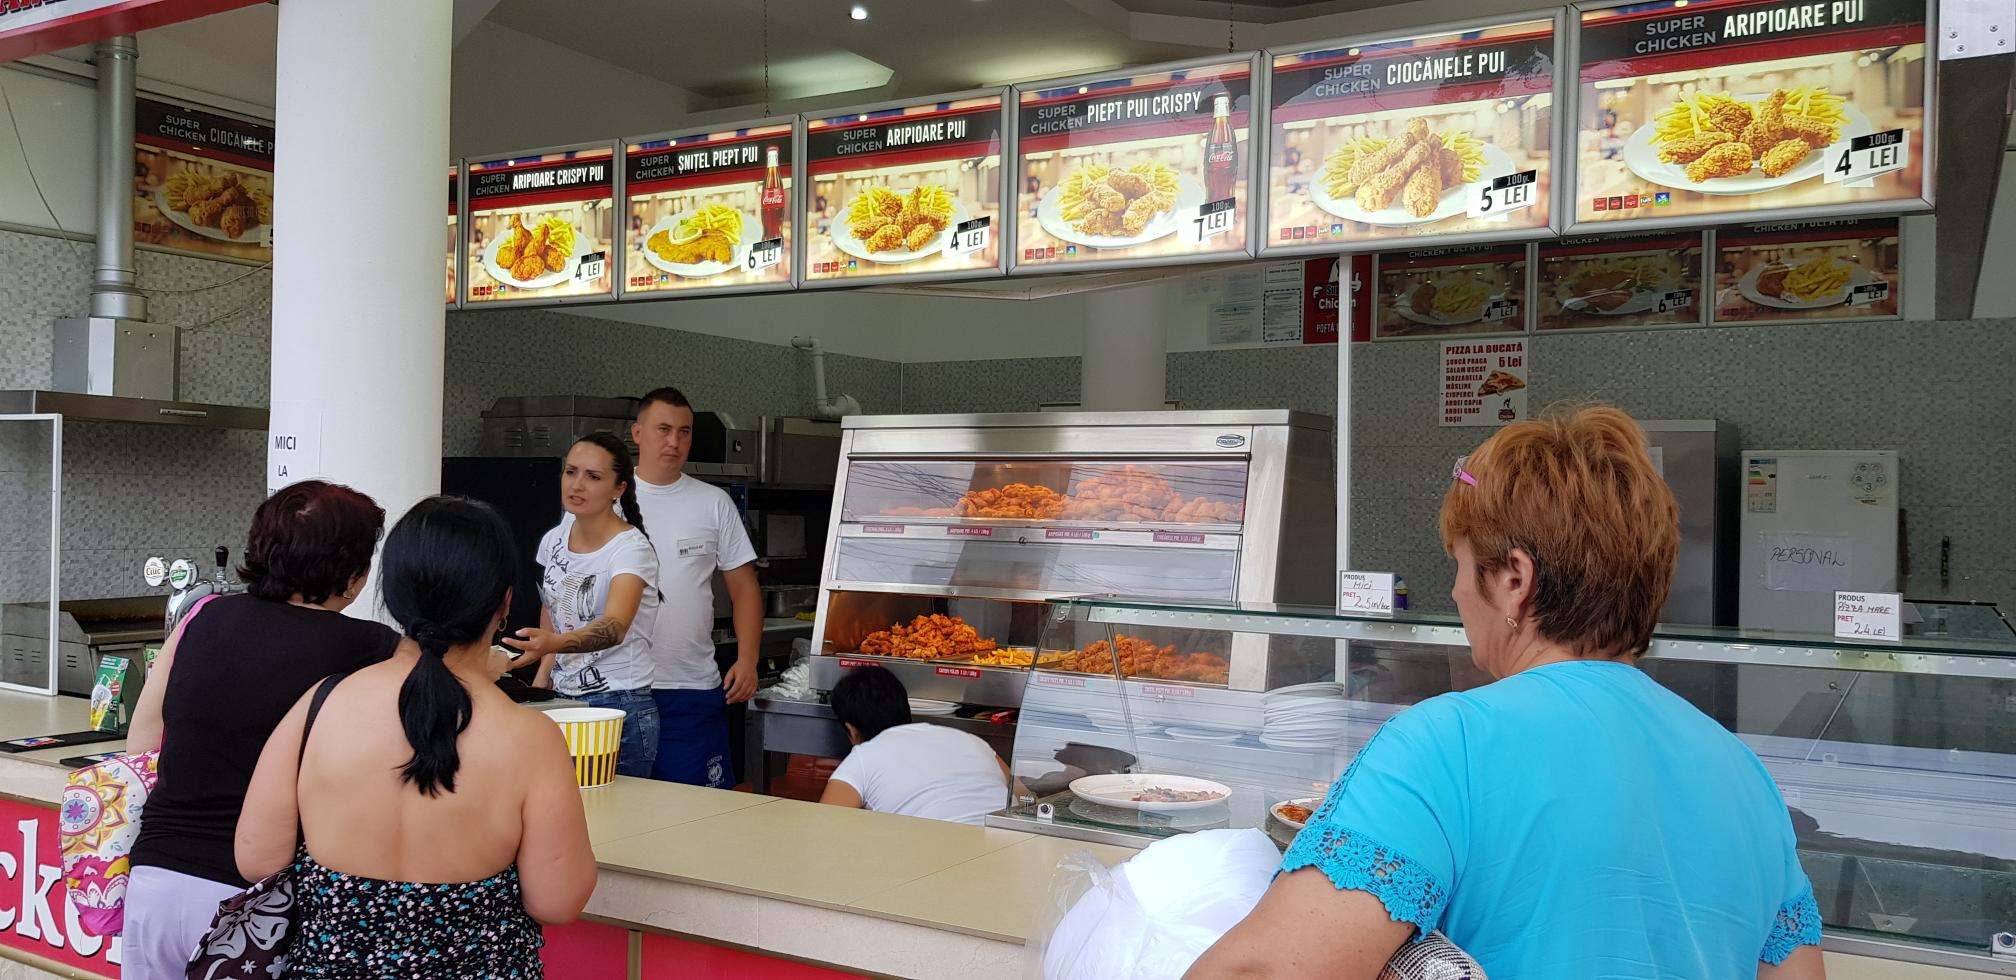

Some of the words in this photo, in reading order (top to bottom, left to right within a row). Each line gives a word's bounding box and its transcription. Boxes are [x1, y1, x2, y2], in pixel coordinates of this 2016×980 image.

[1646, 16, 1705, 36] SUPER
[1722, 3, 1825, 39] ARIPIOARE
[1831, 0, 1864, 24] PUI
[1634, 30, 1717, 54] CHICKEN
[1324, 64, 1372, 81] SUPER
[1386, 54, 1473, 86] CIOCĂNELE
[1478, 51, 1505, 75] PUI
[1315, 78, 1381, 97] CHICKEN
[1038, 104, 1076, 120] SUPER
[1087, 101, 1123, 124] PIEPT
[1126, 97, 1149, 119] PUI
[1152, 91, 1201, 116] CRISPY
[166, 115, 200, 130] SUPER
[1030, 116, 1083, 134] CHICKEN
[159, 125, 206, 142] CHICKEN
[843, 128, 877, 141] SUPER
[886, 122, 944, 147] ARIPIOARE
[947, 119, 966, 139] PUI
[836, 140, 883, 155] CHICKEN
[640, 155, 670, 167] SUPER
[712, 148, 740, 167] PIEPT
[742, 146, 758, 164] PUI
[1835, 149, 1852, 175] 4
[1869, 147, 1899, 169] LEI
[480, 173, 506, 185] SUPER
[512, 170, 556, 191] ARIPIOARE
[557, 166, 588, 186] CRISPY
[589, 165, 604, 182] PUI
[635, 166, 675, 180] CHICKEN
[476, 184, 511, 196] CHICKEN
[1481, 186, 1493, 213] 5
[1504, 184, 1528, 206] LEI
[1193, 217, 1204, 242] 7
[1207, 211, 1228, 231] LEI
[950, 231, 960, 251] 4
[967, 230, 983, 247] LEI
[748, 250, 756, 269] 6
[762, 248, 777, 263] LEI
[575, 263, 582, 281] 4
[588, 263, 600, 276] LEI
[1318, 298, 1357, 310] Chicn
[1659, 299, 1667, 313] 6
[1844, 292, 1853, 306] 4
[1484, 306, 1492, 319] 4
[1501, 307, 1513, 316] LEI
[1446, 345, 1471, 355] PIZZA
[1473, 345, 1484, 354] LA
[1486, 342, 1523, 353] BUCATĂ
[1507, 355, 1522, 368] Lei
[275, 436, 296, 450] MICI
[278, 465, 288, 477] LA
[1770, 546, 1846, 567] PERSONAL
[1838, 594, 1865, 602] PRODUS
